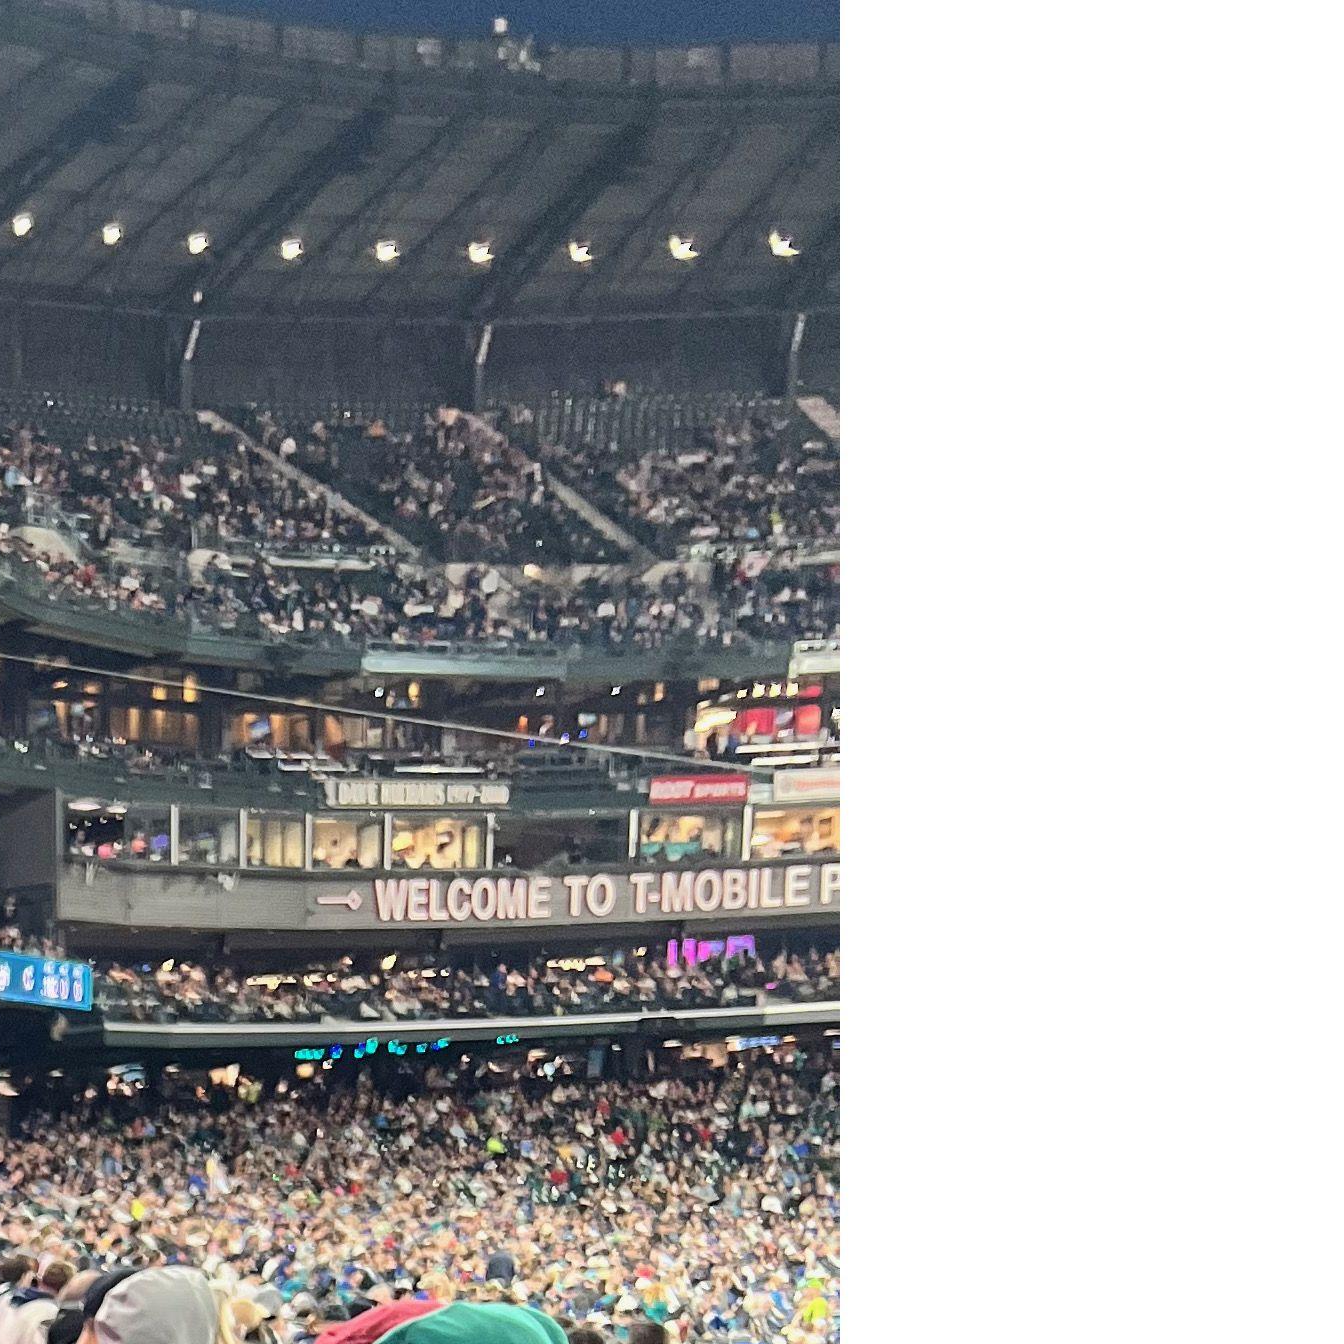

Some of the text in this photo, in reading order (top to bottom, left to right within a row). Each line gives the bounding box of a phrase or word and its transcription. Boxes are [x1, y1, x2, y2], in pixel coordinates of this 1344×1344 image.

[375, 877, 552, 921] WELCOME
[564, 873, 616, 917] TO
[630, 865, 811, 913] T-MOBILE
